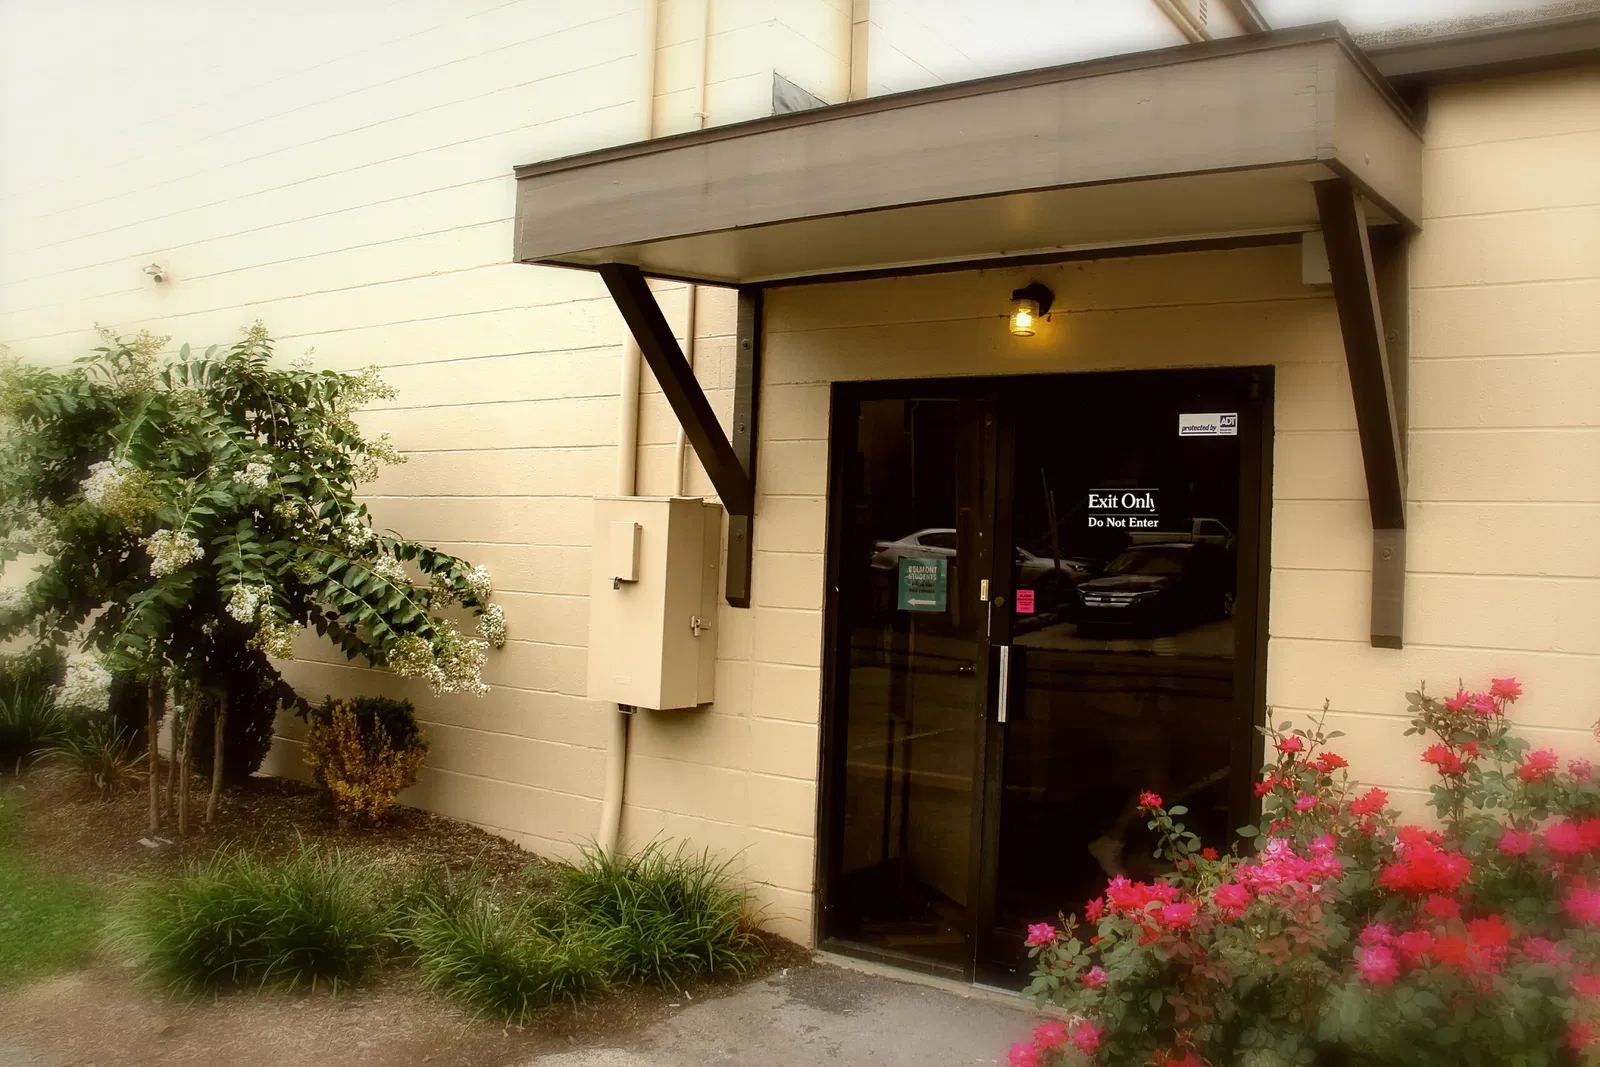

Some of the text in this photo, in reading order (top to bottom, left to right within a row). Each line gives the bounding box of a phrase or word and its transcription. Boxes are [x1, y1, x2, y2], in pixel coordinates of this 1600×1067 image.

[1220, 416, 1236, 426] ADT
[1182, 423, 1217, 433] protected by
[1088, 492, 1156, 512] Exit Only
[1088, 517, 1159, 528] Do Not Enter
[908, 565, 937, 574] BELMONT
[908, 573, 937, 581] STUDENTS
